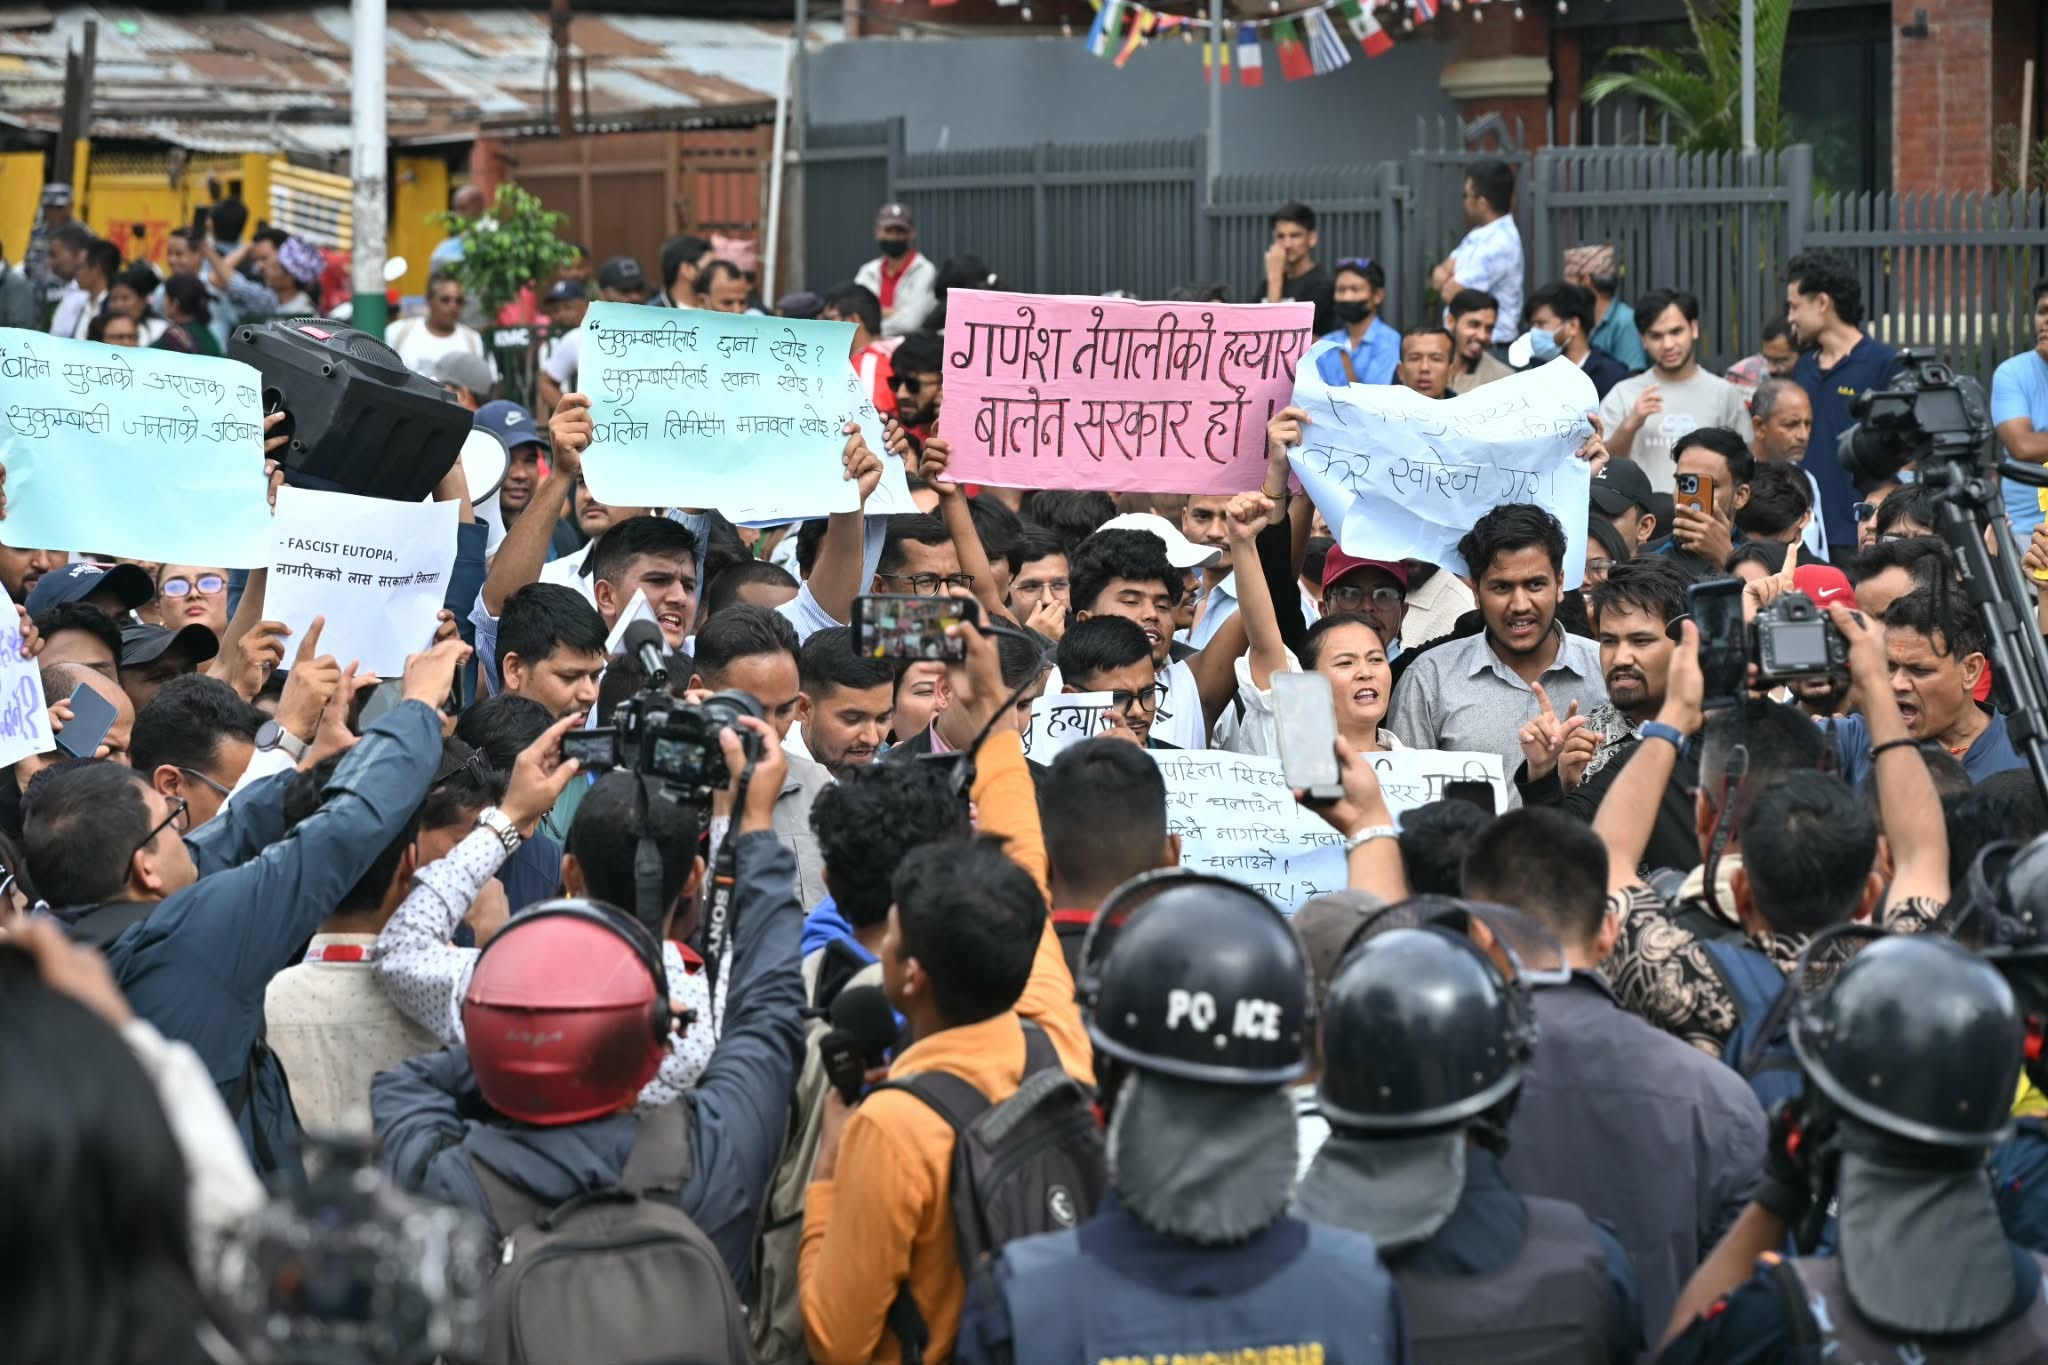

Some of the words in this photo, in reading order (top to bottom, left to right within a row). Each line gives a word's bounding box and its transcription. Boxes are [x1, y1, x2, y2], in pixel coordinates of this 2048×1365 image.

[951, 306, 1072, 383] गणेश
[975, 387, 1071, 458] बालेन
[1074, 400, 1196, 461] सरकार
[1204, 386, 1252, 464] हो
[276, 562, 343, 582] नागरिकको
[347, 571, 374, 586] लास
[288, 537, 340, 555] FASCIST
[707, 888, 731, 960] SONY
[1166, 989, 1283, 1041] POICE
